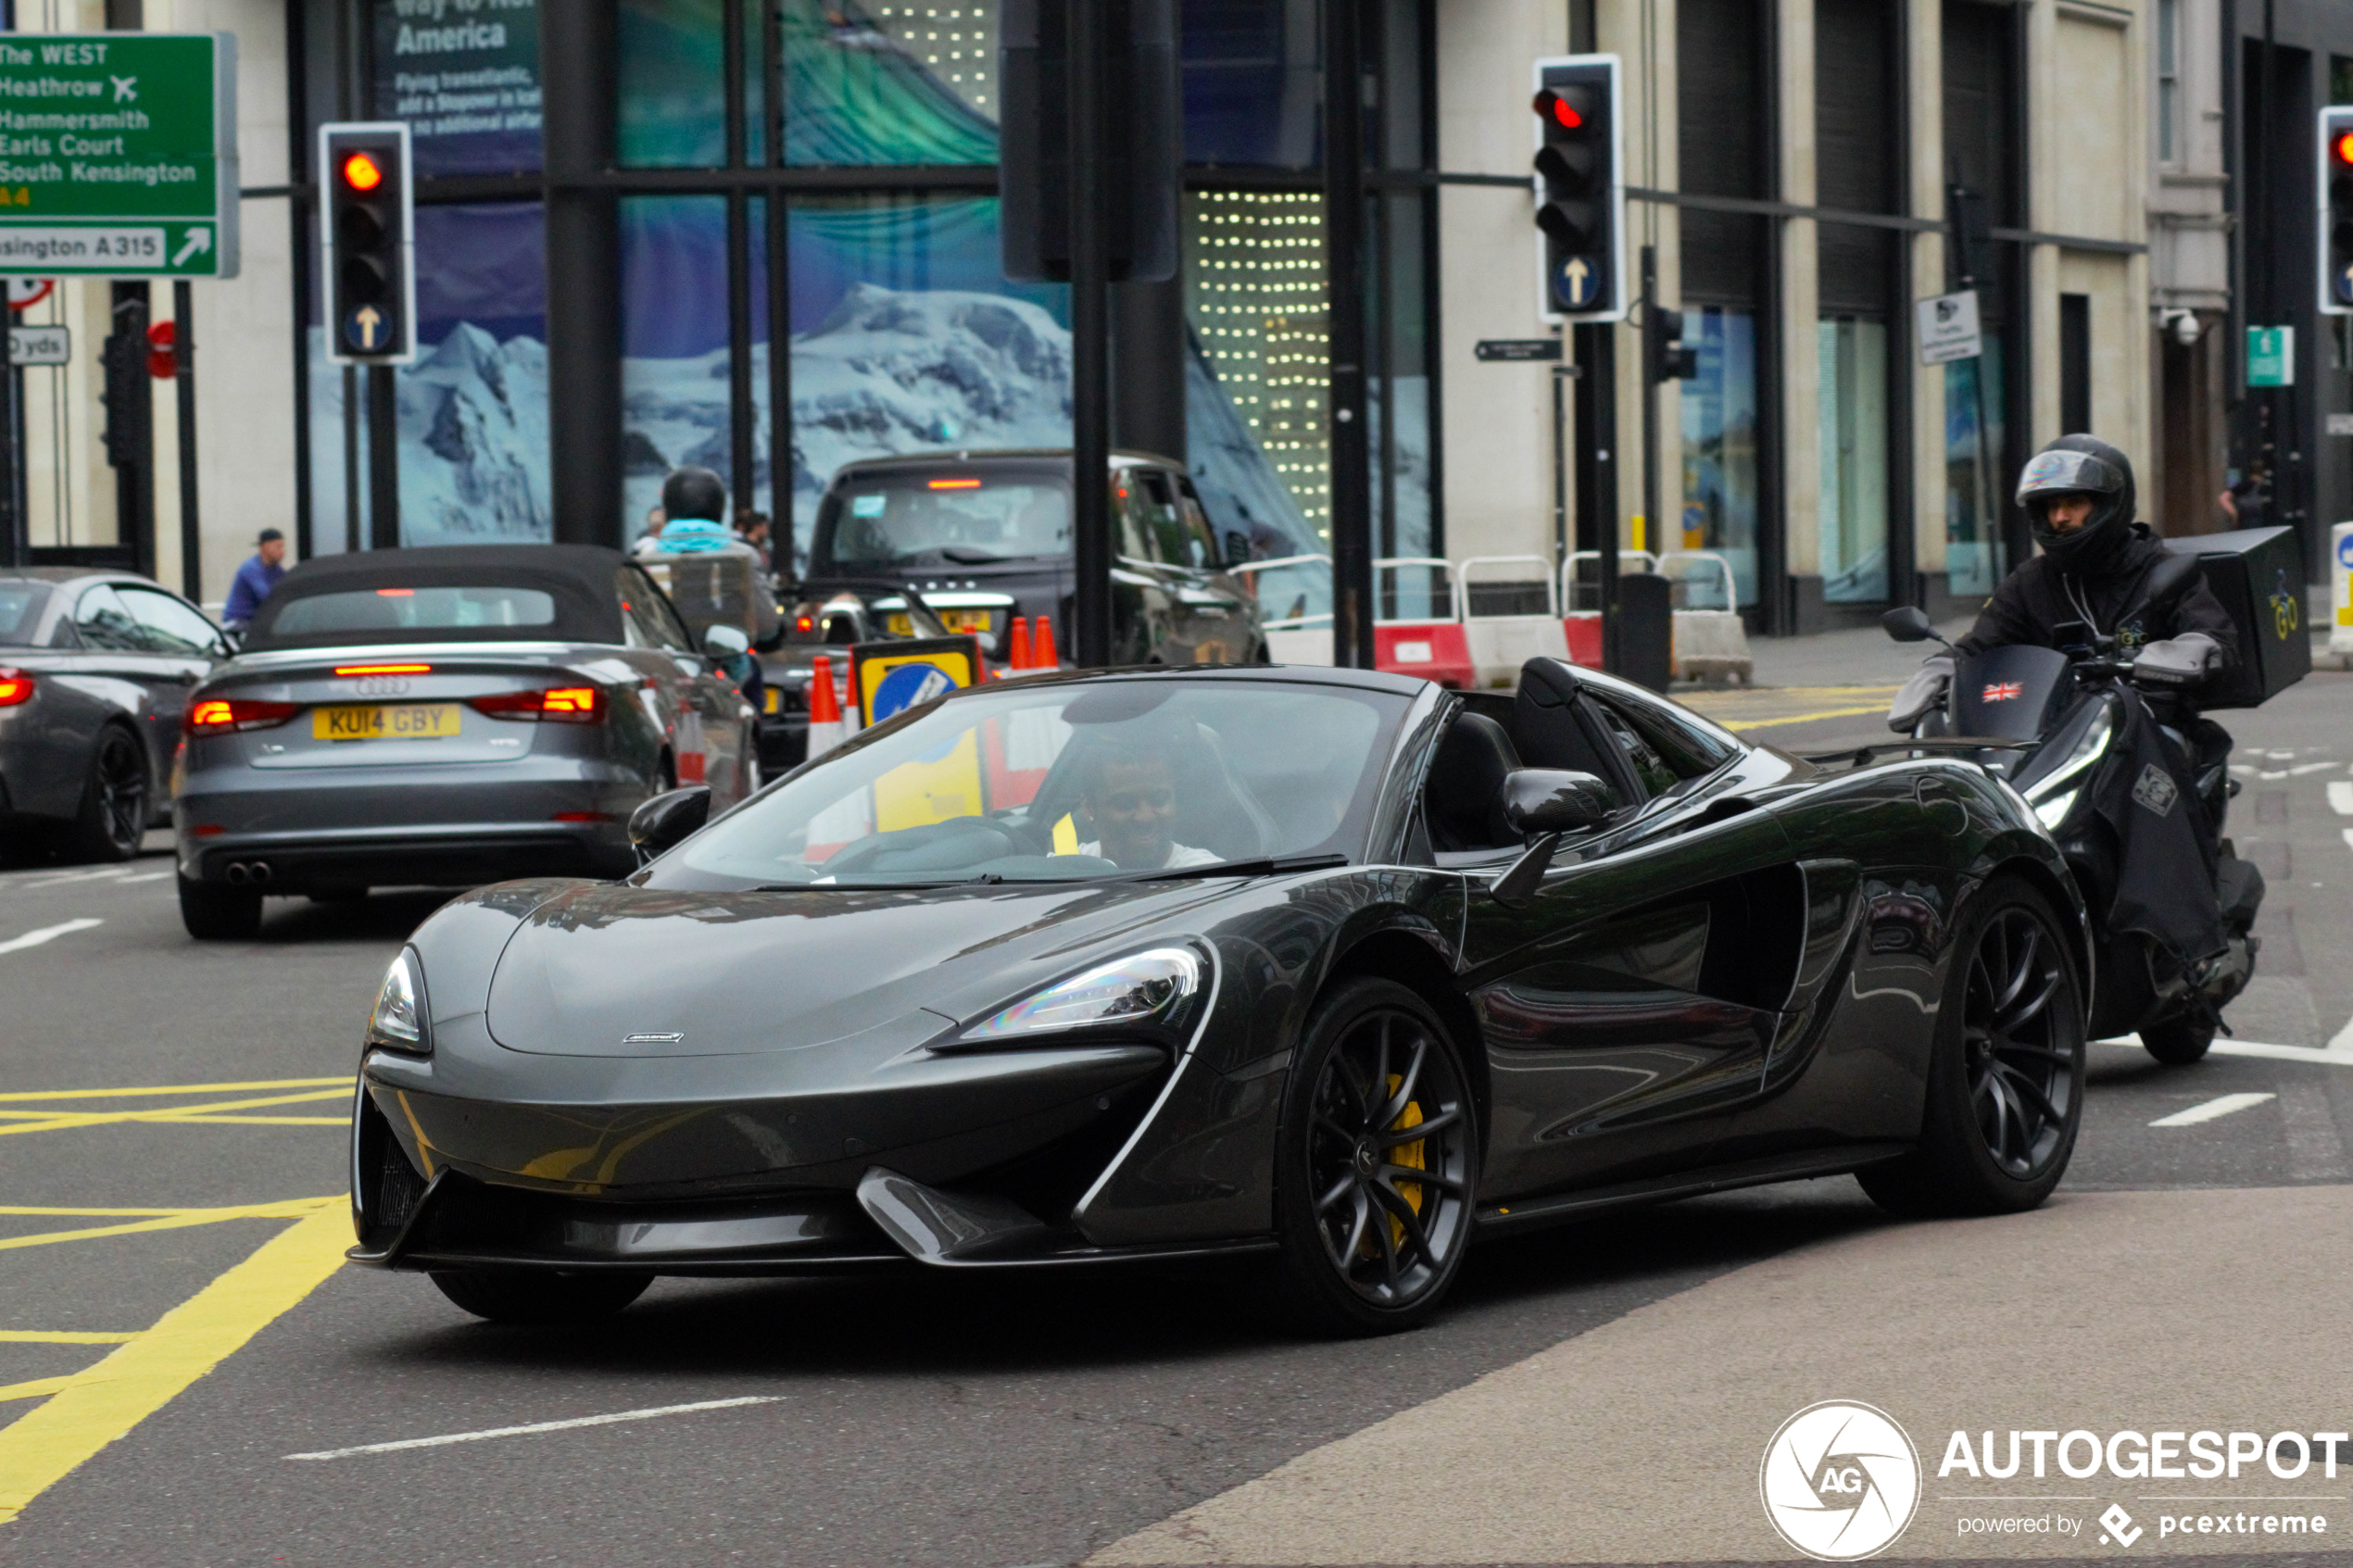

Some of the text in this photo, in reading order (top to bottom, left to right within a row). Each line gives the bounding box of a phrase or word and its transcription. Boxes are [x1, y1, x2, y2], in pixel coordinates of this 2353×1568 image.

[395, 19, 506, 54] America
[0, 44, 108, 65] The WEST
[0, 76, 103, 97] Heathrow
[0, 110, 149, 130] Hammersmith
[0, 134, 124, 157] Earls Court
[0, 160, 196, 186] South Kensington
[0, 186, 31, 207] A4
[0, 237, 86, 259] sington
[25, 336, 61, 358] yds
[329, 707, 446, 734] KU14 GBY
